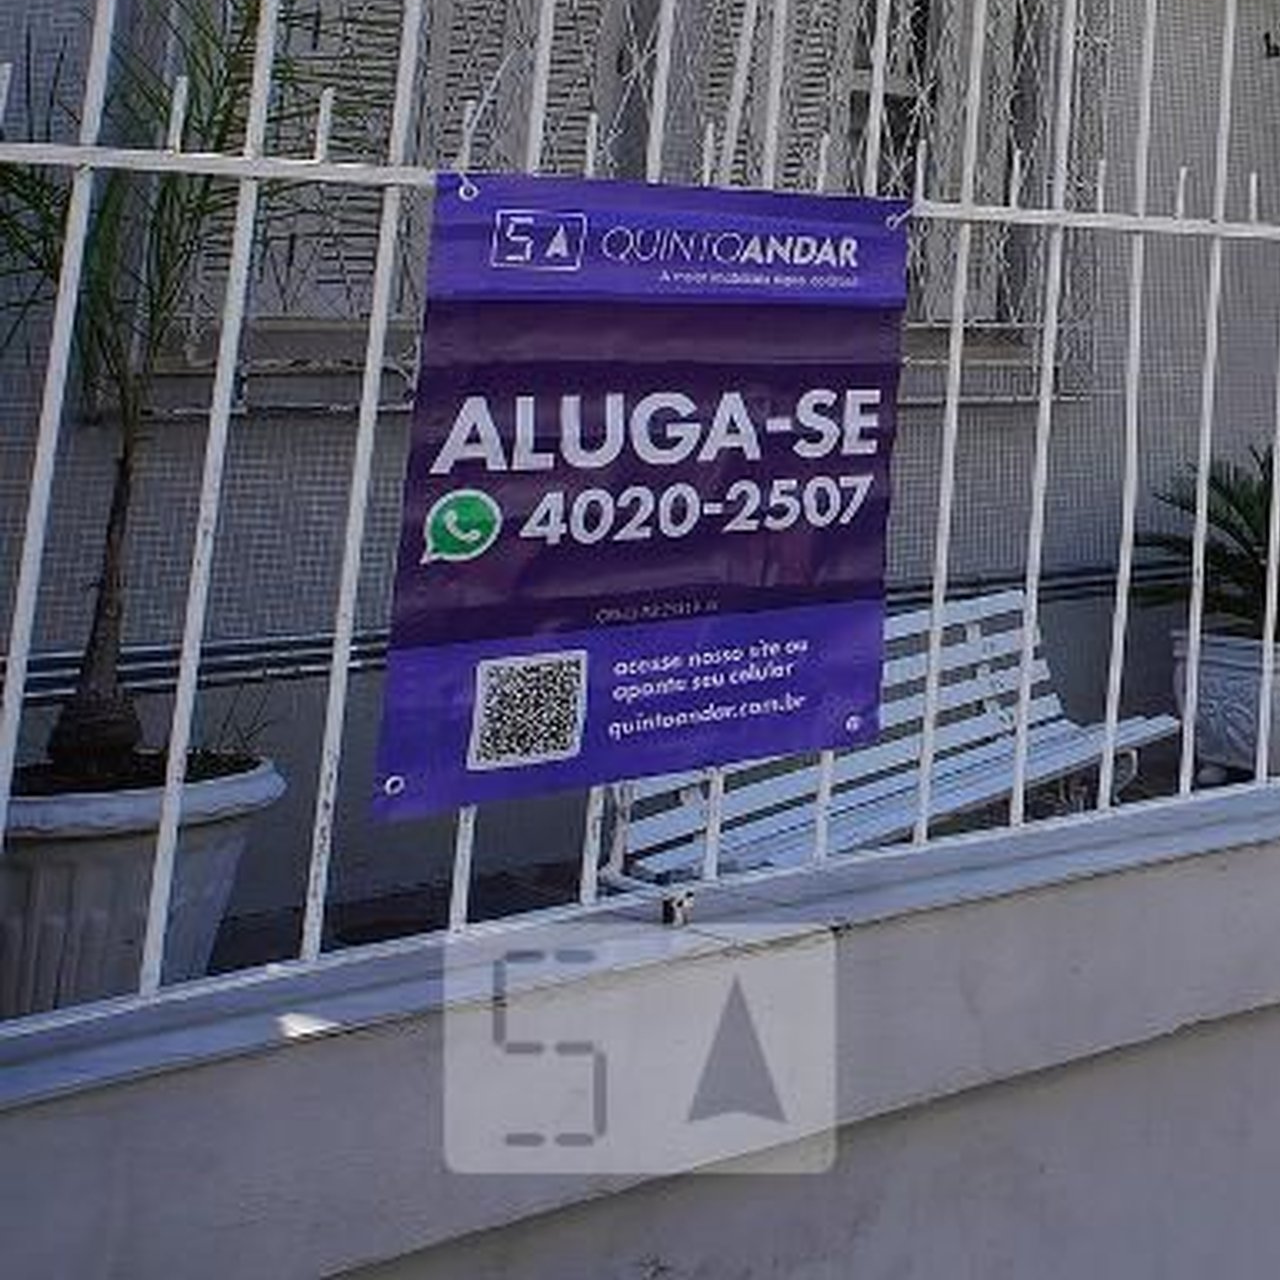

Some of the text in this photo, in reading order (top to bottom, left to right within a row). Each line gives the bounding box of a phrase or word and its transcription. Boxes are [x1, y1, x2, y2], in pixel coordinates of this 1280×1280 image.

[602, 226, 858, 267] QUINTOANDAR
[430, 389, 881, 474] ALUGA-SE
[519, 474, 875, 545] 4020-2507
[688, 646, 744, 668] nosso
[784, 639, 808, 653] ou
[612, 661, 794, 704] aponte seu celular
[608, 693, 806, 740] quintoandar.com.br
